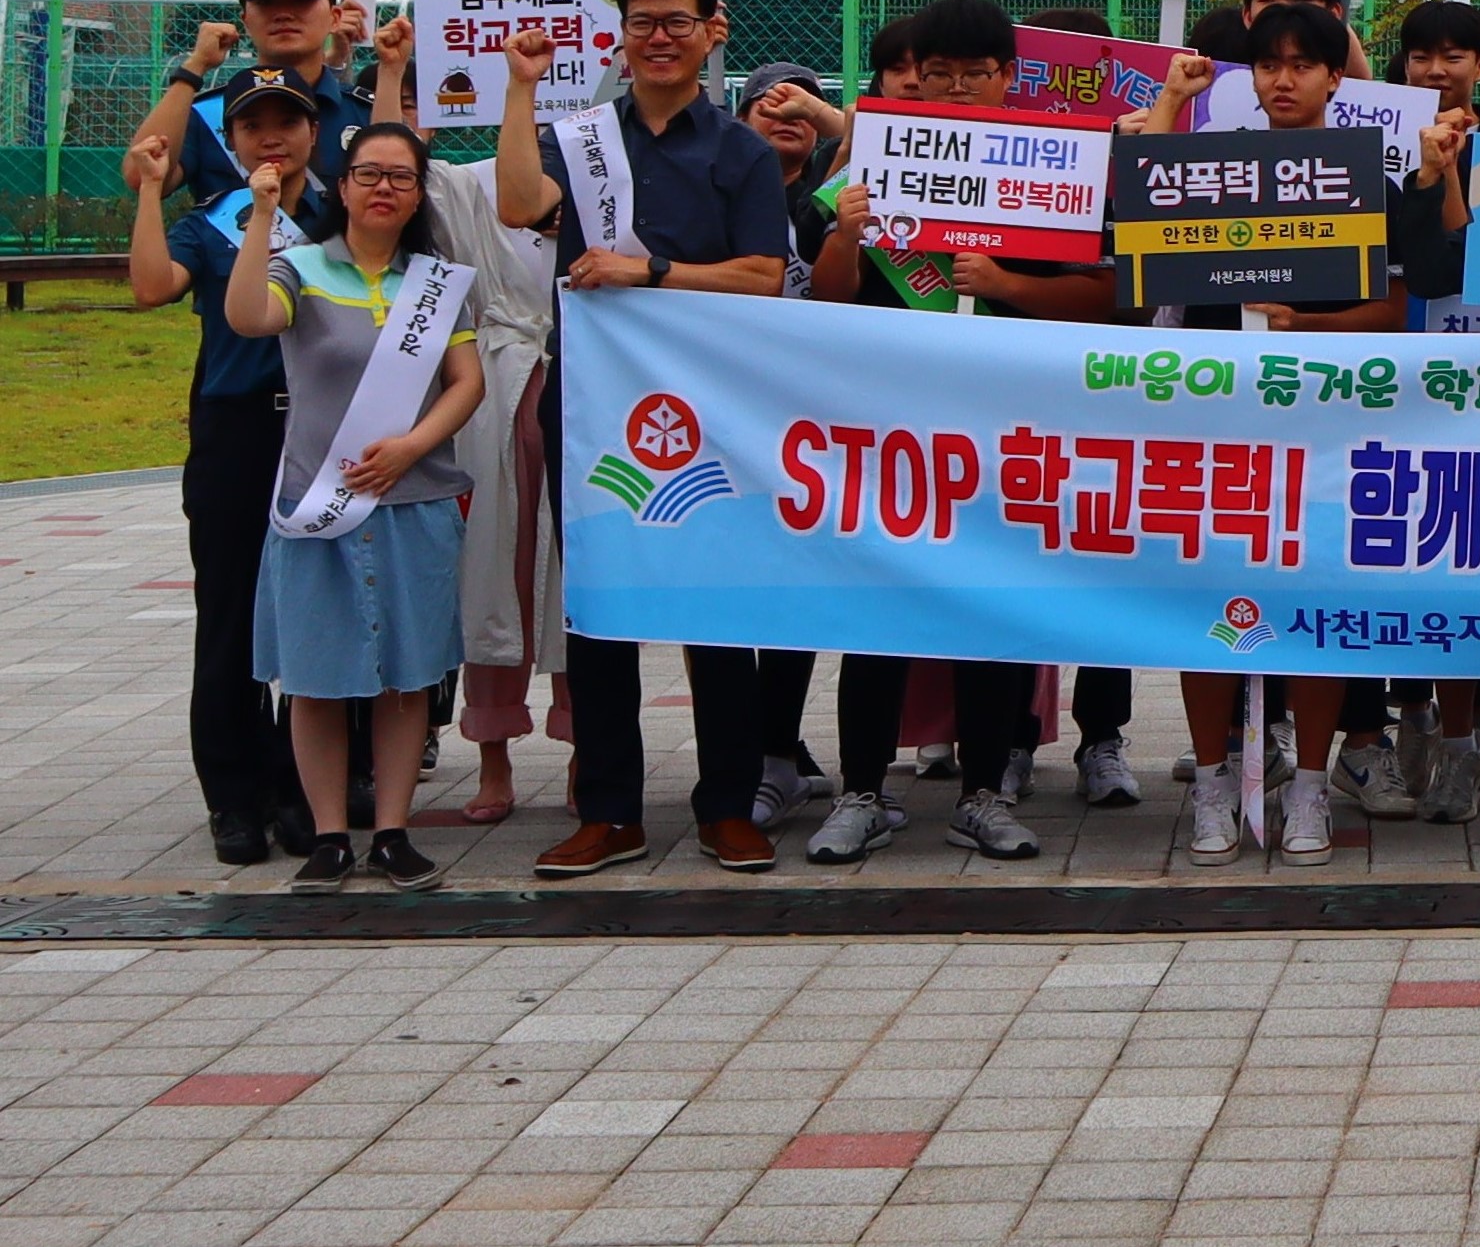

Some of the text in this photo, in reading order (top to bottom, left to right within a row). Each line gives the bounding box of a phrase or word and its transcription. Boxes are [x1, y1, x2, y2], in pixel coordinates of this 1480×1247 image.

[884, 125, 1078, 171] 너라서 고마워!
[862, 167, 1093, 215] 너 덕분에 행복해!
[1146, 159, 1260, 206] 성폭력
[1274, 158, 1350, 202] 없는
[942, 230, 1003, 248] 사천중학교
[1162, 221, 1336, 245] 안전한 우리학교
[1209, 268, 1293, 285] 사천교육지원청
[1086, 351, 1236, 401] 배움이
[1257, 353, 1400, 408] 즐거운
[777, 419, 979, 540] STOP
[1000, 426, 1305, 566] 학교폭력!
